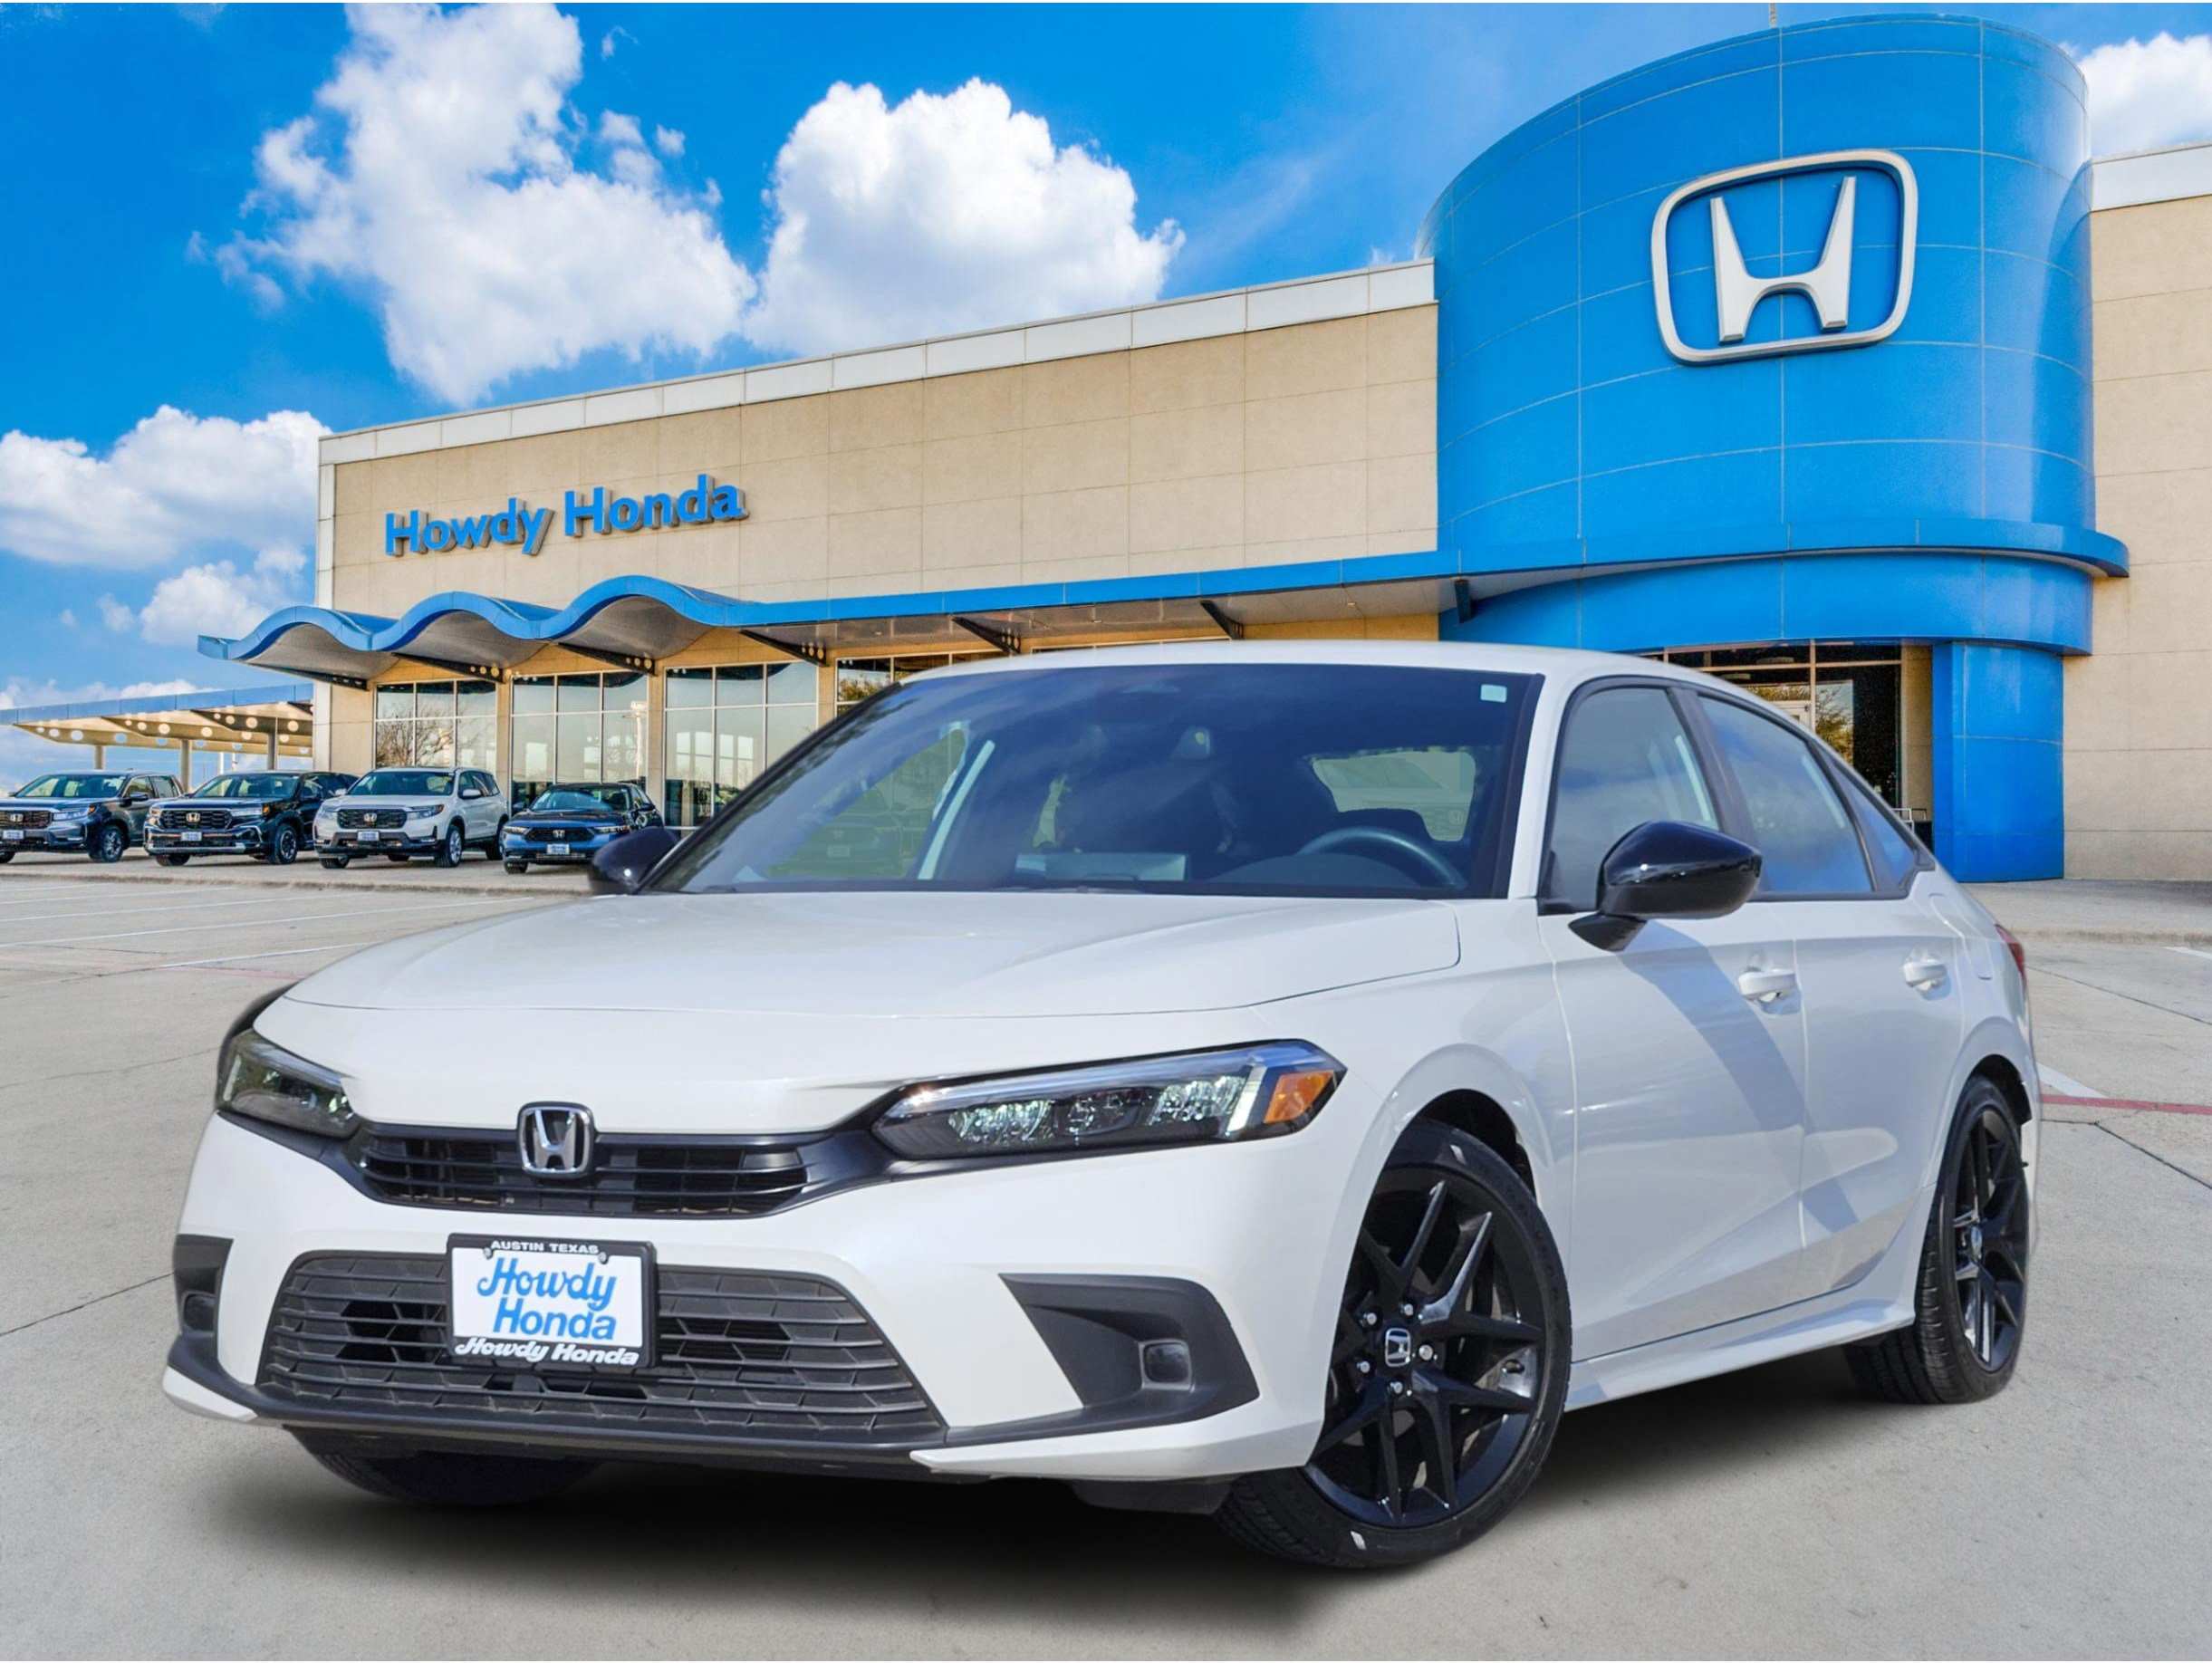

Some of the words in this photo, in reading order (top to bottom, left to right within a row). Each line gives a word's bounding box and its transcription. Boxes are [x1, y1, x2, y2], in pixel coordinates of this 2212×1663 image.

[385, 497, 554, 556] Howdy
[564, 474, 749, 537] Honda
[491, 1240, 544, 1251] AUSTIN
[549, 1243, 599, 1254] TEXAS
[477, 1257, 617, 1312] Howdy
[493, 1297, 617, 1340] Honda
[455, 1337, 549, 1362] Howdy
[551, 1343, 640, 1365] Honda
